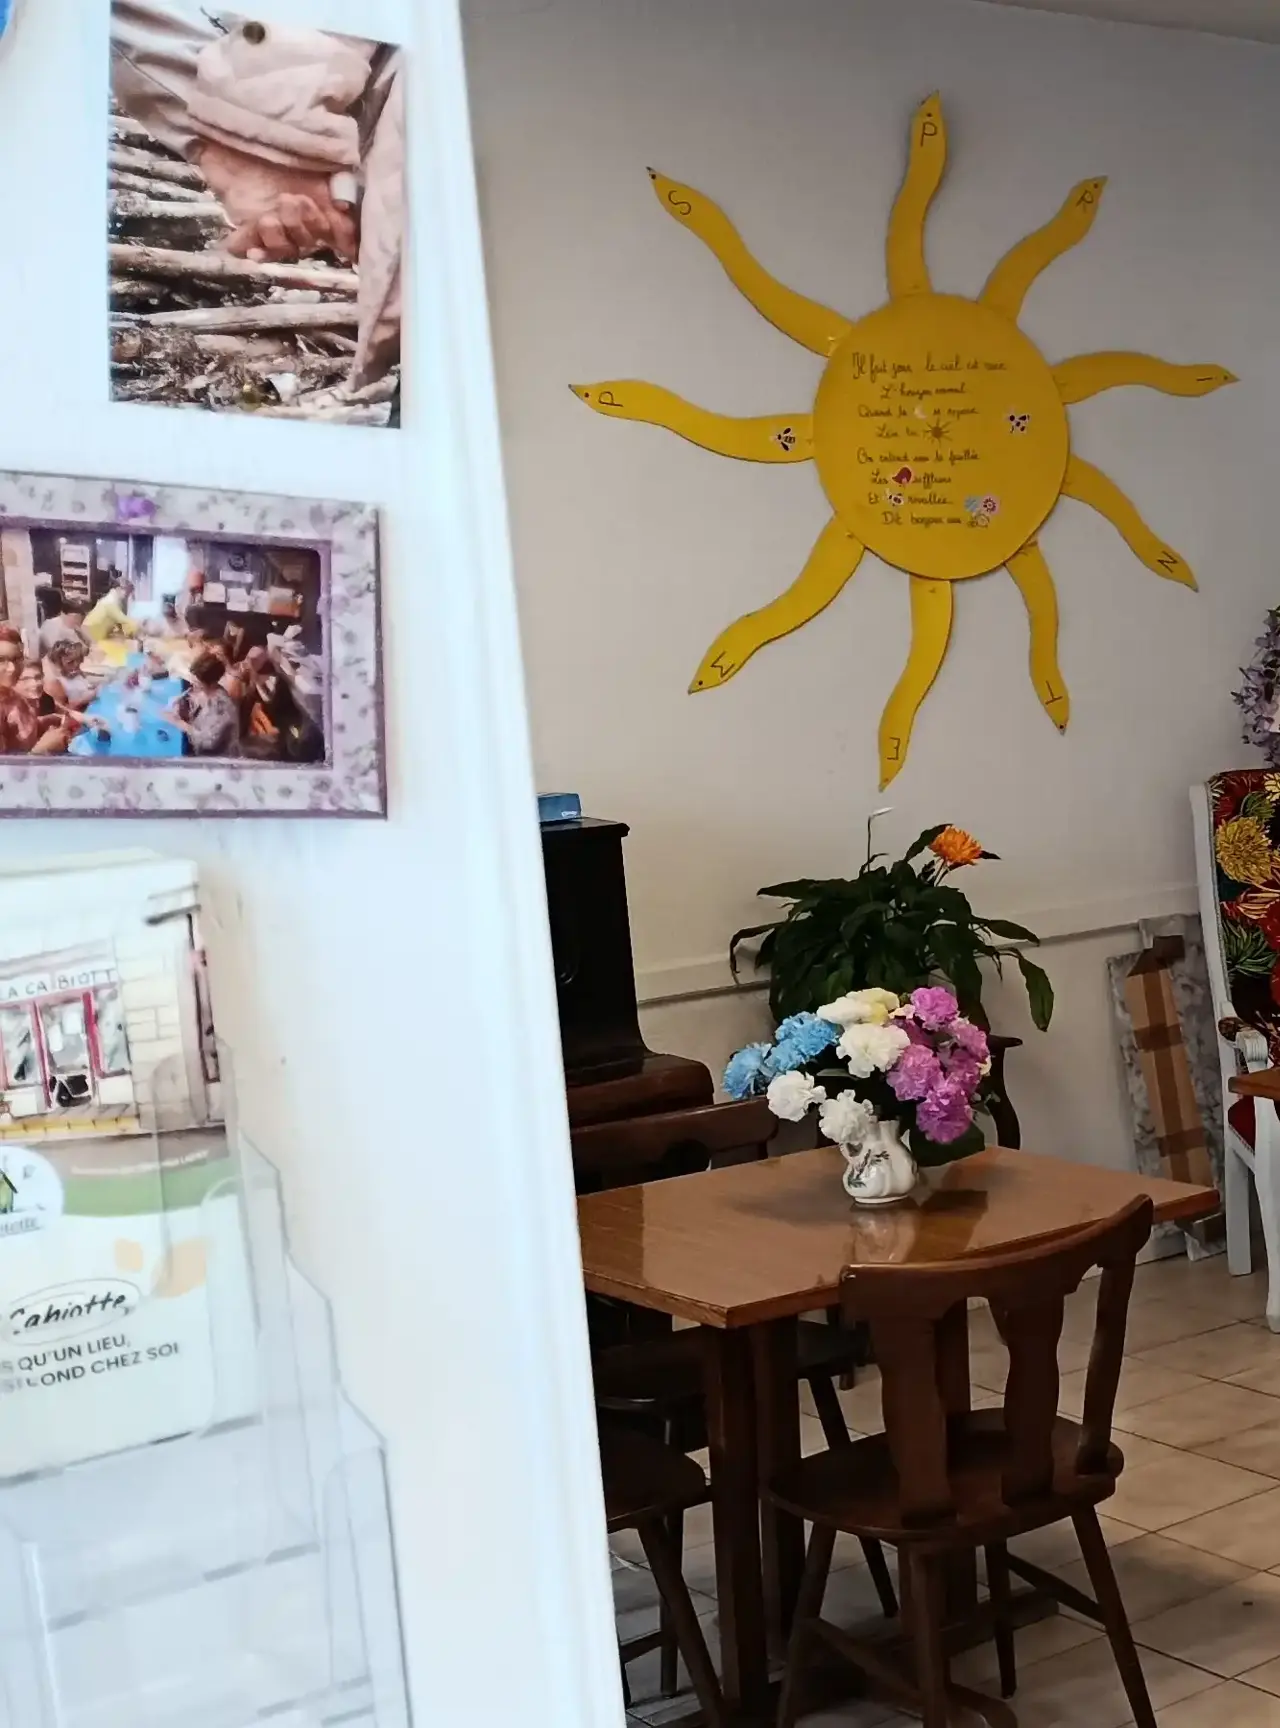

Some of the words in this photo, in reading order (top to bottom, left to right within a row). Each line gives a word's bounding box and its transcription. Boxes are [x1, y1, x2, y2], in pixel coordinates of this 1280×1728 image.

[920, 121, 938, 147] P
[668, 190, 691, 215] S
[1076, 190, 1094, 212] R
[1045, 680, 1063, 705] T
[887, 737, 901, 760] E
[91, 1351, 142, 1373] CHEZ
[146, 1342, 179, 1360] SOI
